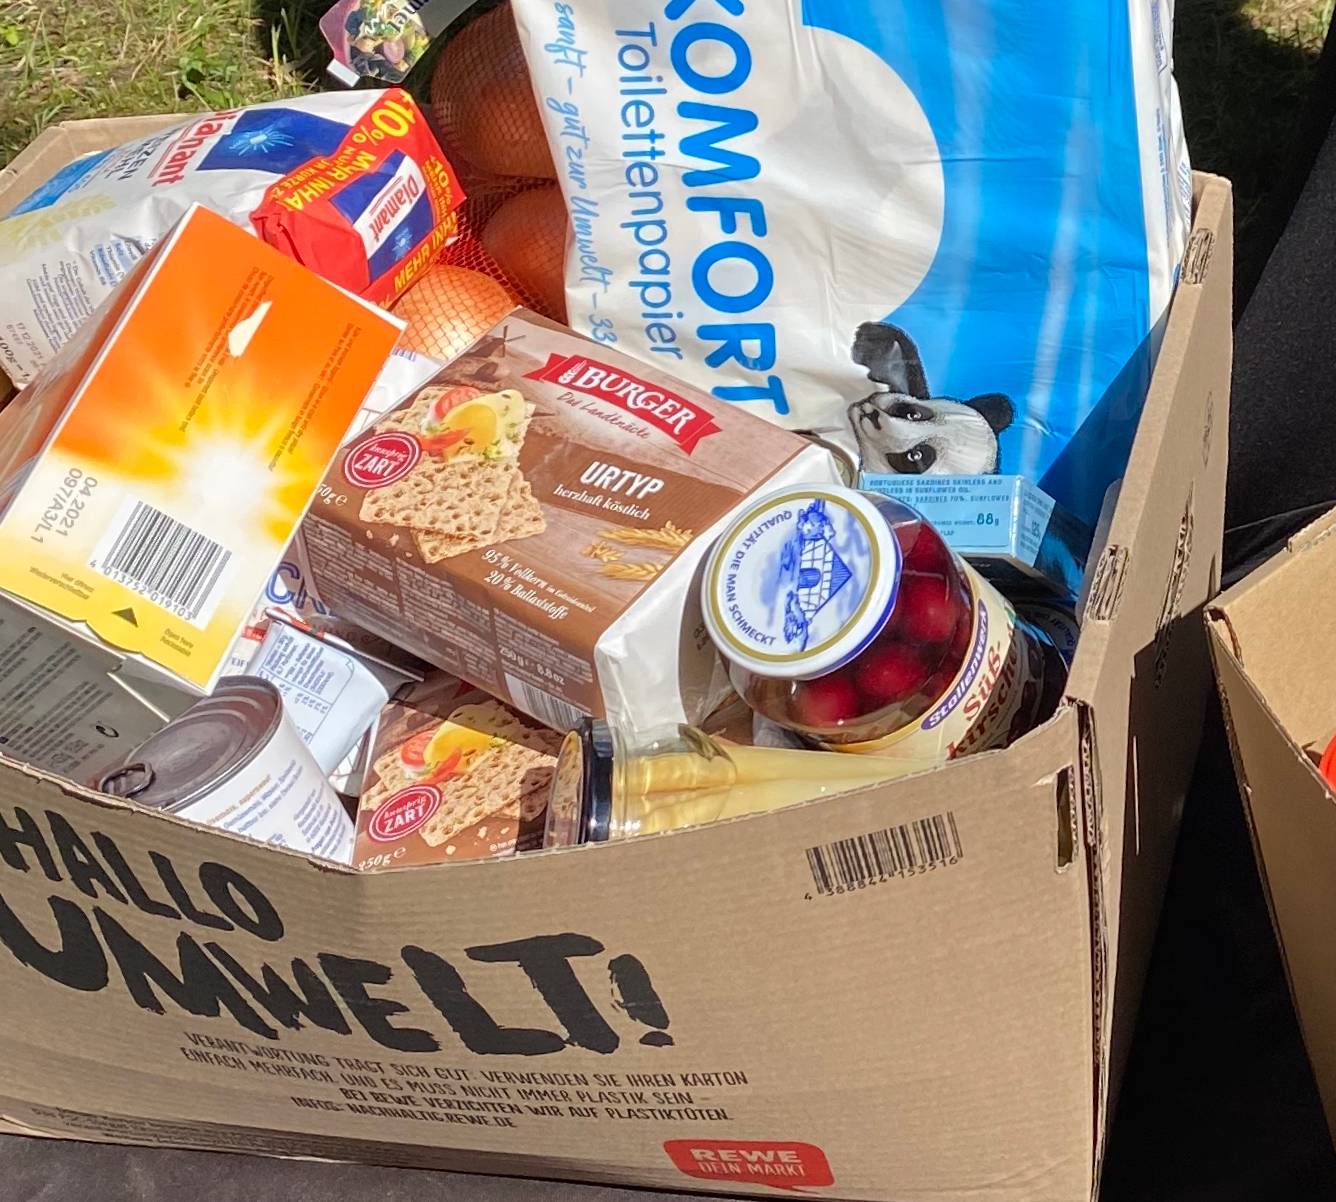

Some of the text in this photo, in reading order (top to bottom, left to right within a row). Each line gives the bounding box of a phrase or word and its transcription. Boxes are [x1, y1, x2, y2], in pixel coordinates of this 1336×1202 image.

[545, 2, 588, 78] sanft
[547, 97, 589, 149] gut
[566, 144, 589, 189] zur
[614, 21, 683, 360] Toilettenpapier
[369, 173, 419, 243] Diamant
[664, 0, 790, 415] OMFORT
[393, 245, 430, 290] MEHR
[571, 195, 608, 293] Umwelt
[557, 391, 577, 408] Das
[574, 366, 697, 435] BURGER
[354, 451, 400, 477] ZART
[580, 461, 665, 499] URTYP
[56, 476, 98, 537] 04.2021
[553, 484, 651, 520] herzhaft köstlich
[89, 559, 97, 569] 4
[726, 510, 793, 647] QUALITÄT DIE MAN SCHMECKT
[927, 609, 988, 728] Stollenwerk
[383, 807, 426, 833] ZART
[0, 805, 285, 942] HALLO
[0, 893, 675, 1057] UMWELT!
[180, 1046, 247, 1071] EINFACH
[341, 1074, 378, 1090] UND
[382, 1078, 403, 1091] ES
[406, 1079, 457, 1096] MUSS
[461, 1083, 511, 1100] NICHT
[516, 1089, 571, 1103] IMMER
[577, 1090, 648, 1105] PLASTIK
[652, 1091, 695, 1106] SEIN
[184, 1031, 331, 1068] VERANTWORTUNG
[390, 1063, 430, 1079] SICH
[484, 1070, 589, 1086] VERWENDEN
[594, 1073, 619, 1087] SIE
[626, 1072, 676, 1087] IHREN
[679, 1071, 749, 1086] KARTON
[338, 1087, 370, 1102] BEI
[372, 1090, 424, 1108] REWE
[426, 1095, 523, 1116] VERZICHTEN
[523, 1104, 563, 1117] WIR
[568, 1105, 600, 1119] AUF
[690, 1148, 802, 1163] REWE
[699, 1160, 806, 1177] DEIN MARKT
